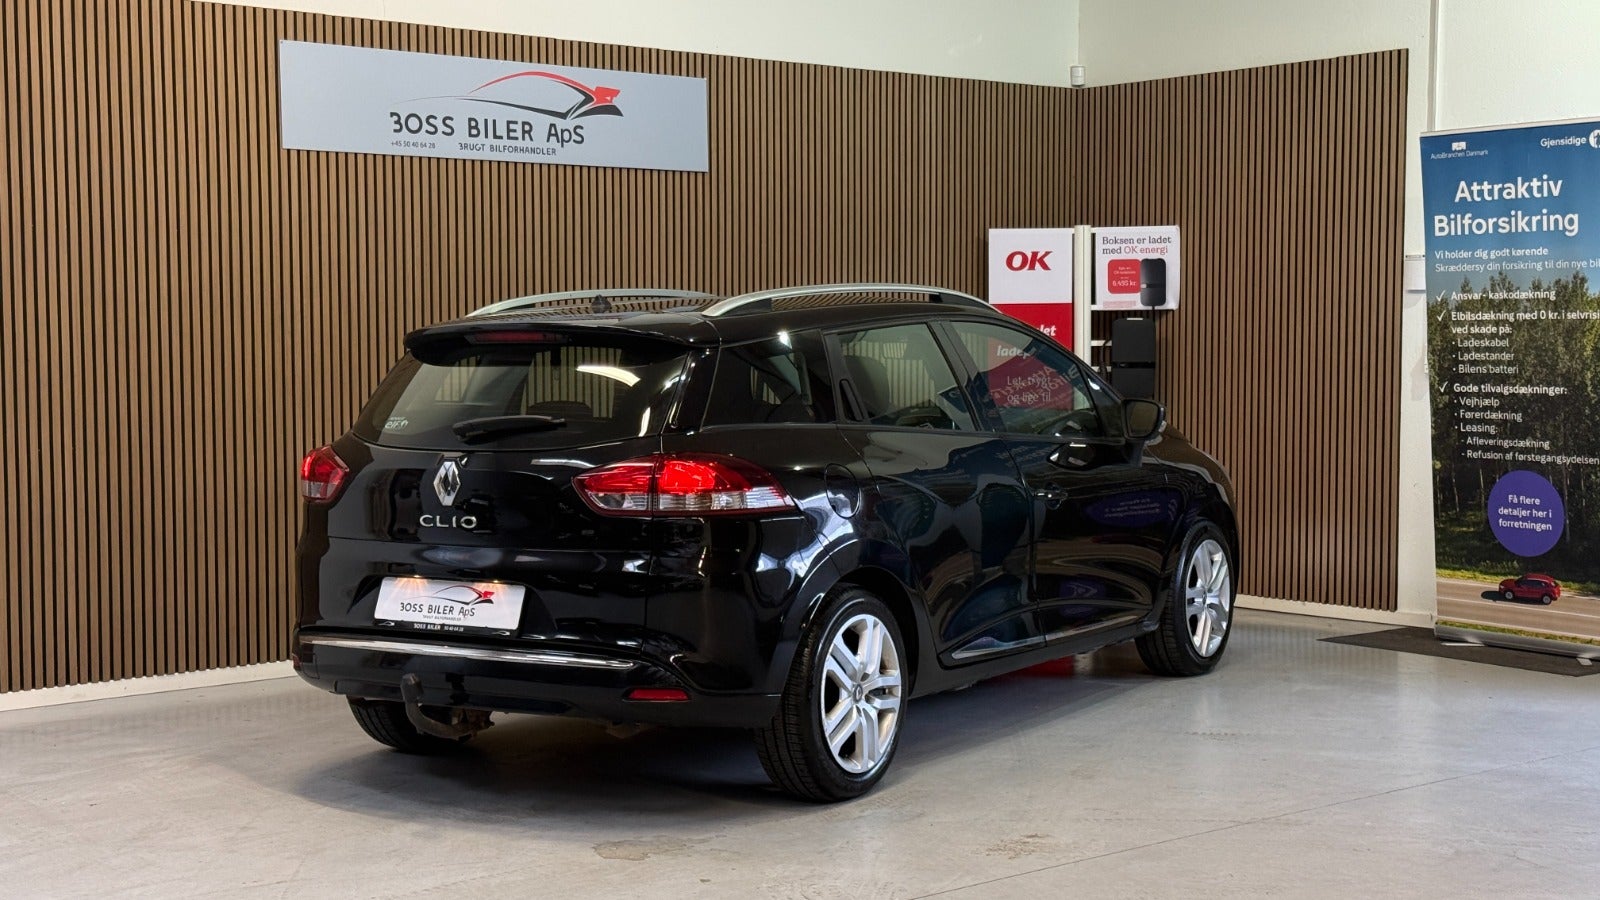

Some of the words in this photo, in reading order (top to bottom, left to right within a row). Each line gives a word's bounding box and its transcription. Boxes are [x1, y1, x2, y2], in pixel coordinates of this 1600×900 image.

[468, 117, 534, 142] BILER
[546, 122, 585, 148] ApS
[1540, 136, 1587, 148] Gjensidige
[490, 144, 556, 156] BILFORHANDLER
[1454, 174, 1563, 203] Attraktiv
[1434, 208, 1579, 237] Bilforsikring
[1102, 236, 1134, 244] Boksen
[1148, 236, 1172, 244] ladet
[1124, 246, 1138, 254] OK
[1140, 246, 1168, 255] energi
[1434, 250, 1444, 259] Vi
[1445, 250, 1472, 258] holder
[1474, 249, 1488, 259] dig
[1490, 248, 1510, 259] godt
[1512, 247, 1549, 257] kørende
[1006, 250, 1052, 272] OK
[1435, 263, 1484, 272] Skræddersy
[1487, 262, 1500, 270] din
[1502, 260, 1542, 270] forsikring
[1545, 260, 1554, 268] til
[1555, 260, 1569, 268] din
[1571, 261, 1587, 270] nye
[1488, 289, 1556, 300] kaskodækning
[1451, 311, 1515, 322] Elbilsdækning
[1516, 311, 1538, 320] med
[1540, 310, 1546, 320] 0
[1548, 310, 1560, 320] kr.
[1562, 310, 1565, 320] i
[1451, 325, 1468, 334] ved
[1470, 324, 1497, 334] skade
[1499, 324, 1512, 335] på:
[1457, 338, 1509, 347] Ladeskabel
[1458, 351, 1515, 361] Ladestander
[1458, 364, 1487, 374] Bilens
[1489, 364, 1519, 374] batteri
[1453, 383, 1479, 392] Gode
[1481, 383, 1568, 396] tilvalgsdækninger:
[1459, 397, 1500, 408] Vejhjælp
[1460, 410, 1522, 422] Førerdækning
[1460, 423, 1498, 434] Leasing:
[1466, 436, 1550, 450] Afleveringsdækning
[1467, 450, 1503, 460] Refusion
[1505, 452, 1513, 460] af
[1508, 494, 1518, 503] Få
[1520, 496, 1540, 505] flere
[1498, 507, 1531, 518] detaljer
[1532, 509, 1547, 518] her
[1549, 509, 1552, 518] i
[420, 514, 477, 529] CLIO
[1498, 518, 1552, 532] forretningen
[428, 604, 454, 615] BILER
[458, 607, 476, 618] ApS
